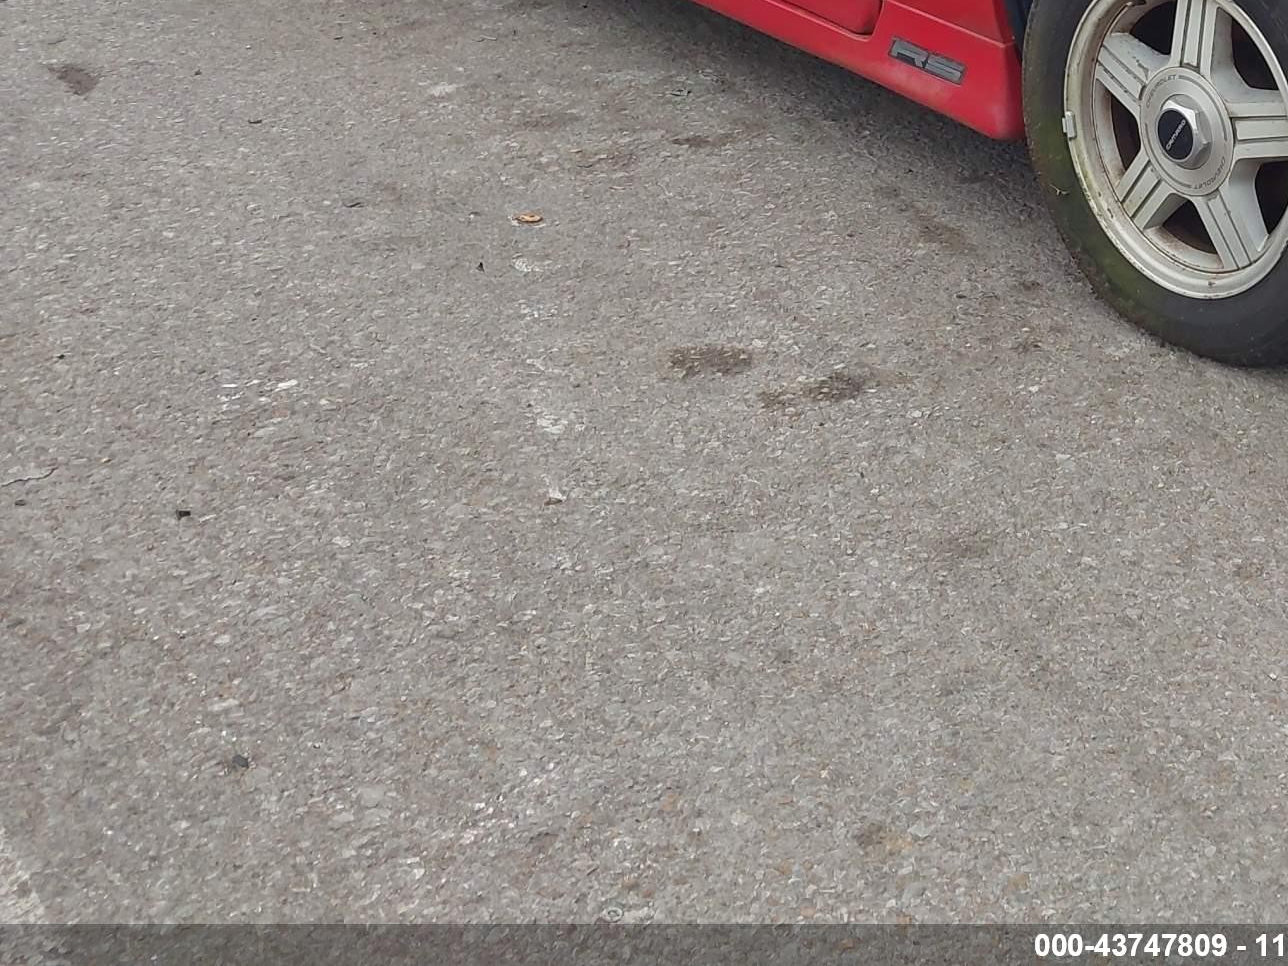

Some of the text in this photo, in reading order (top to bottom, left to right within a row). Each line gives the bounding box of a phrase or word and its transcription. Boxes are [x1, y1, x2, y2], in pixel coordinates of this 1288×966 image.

[890, 39, 966, 84] RS
[1146, 73, 1178, 108] CHEVROLET
[1192, 157, 1226, 190] CHEVROLET
